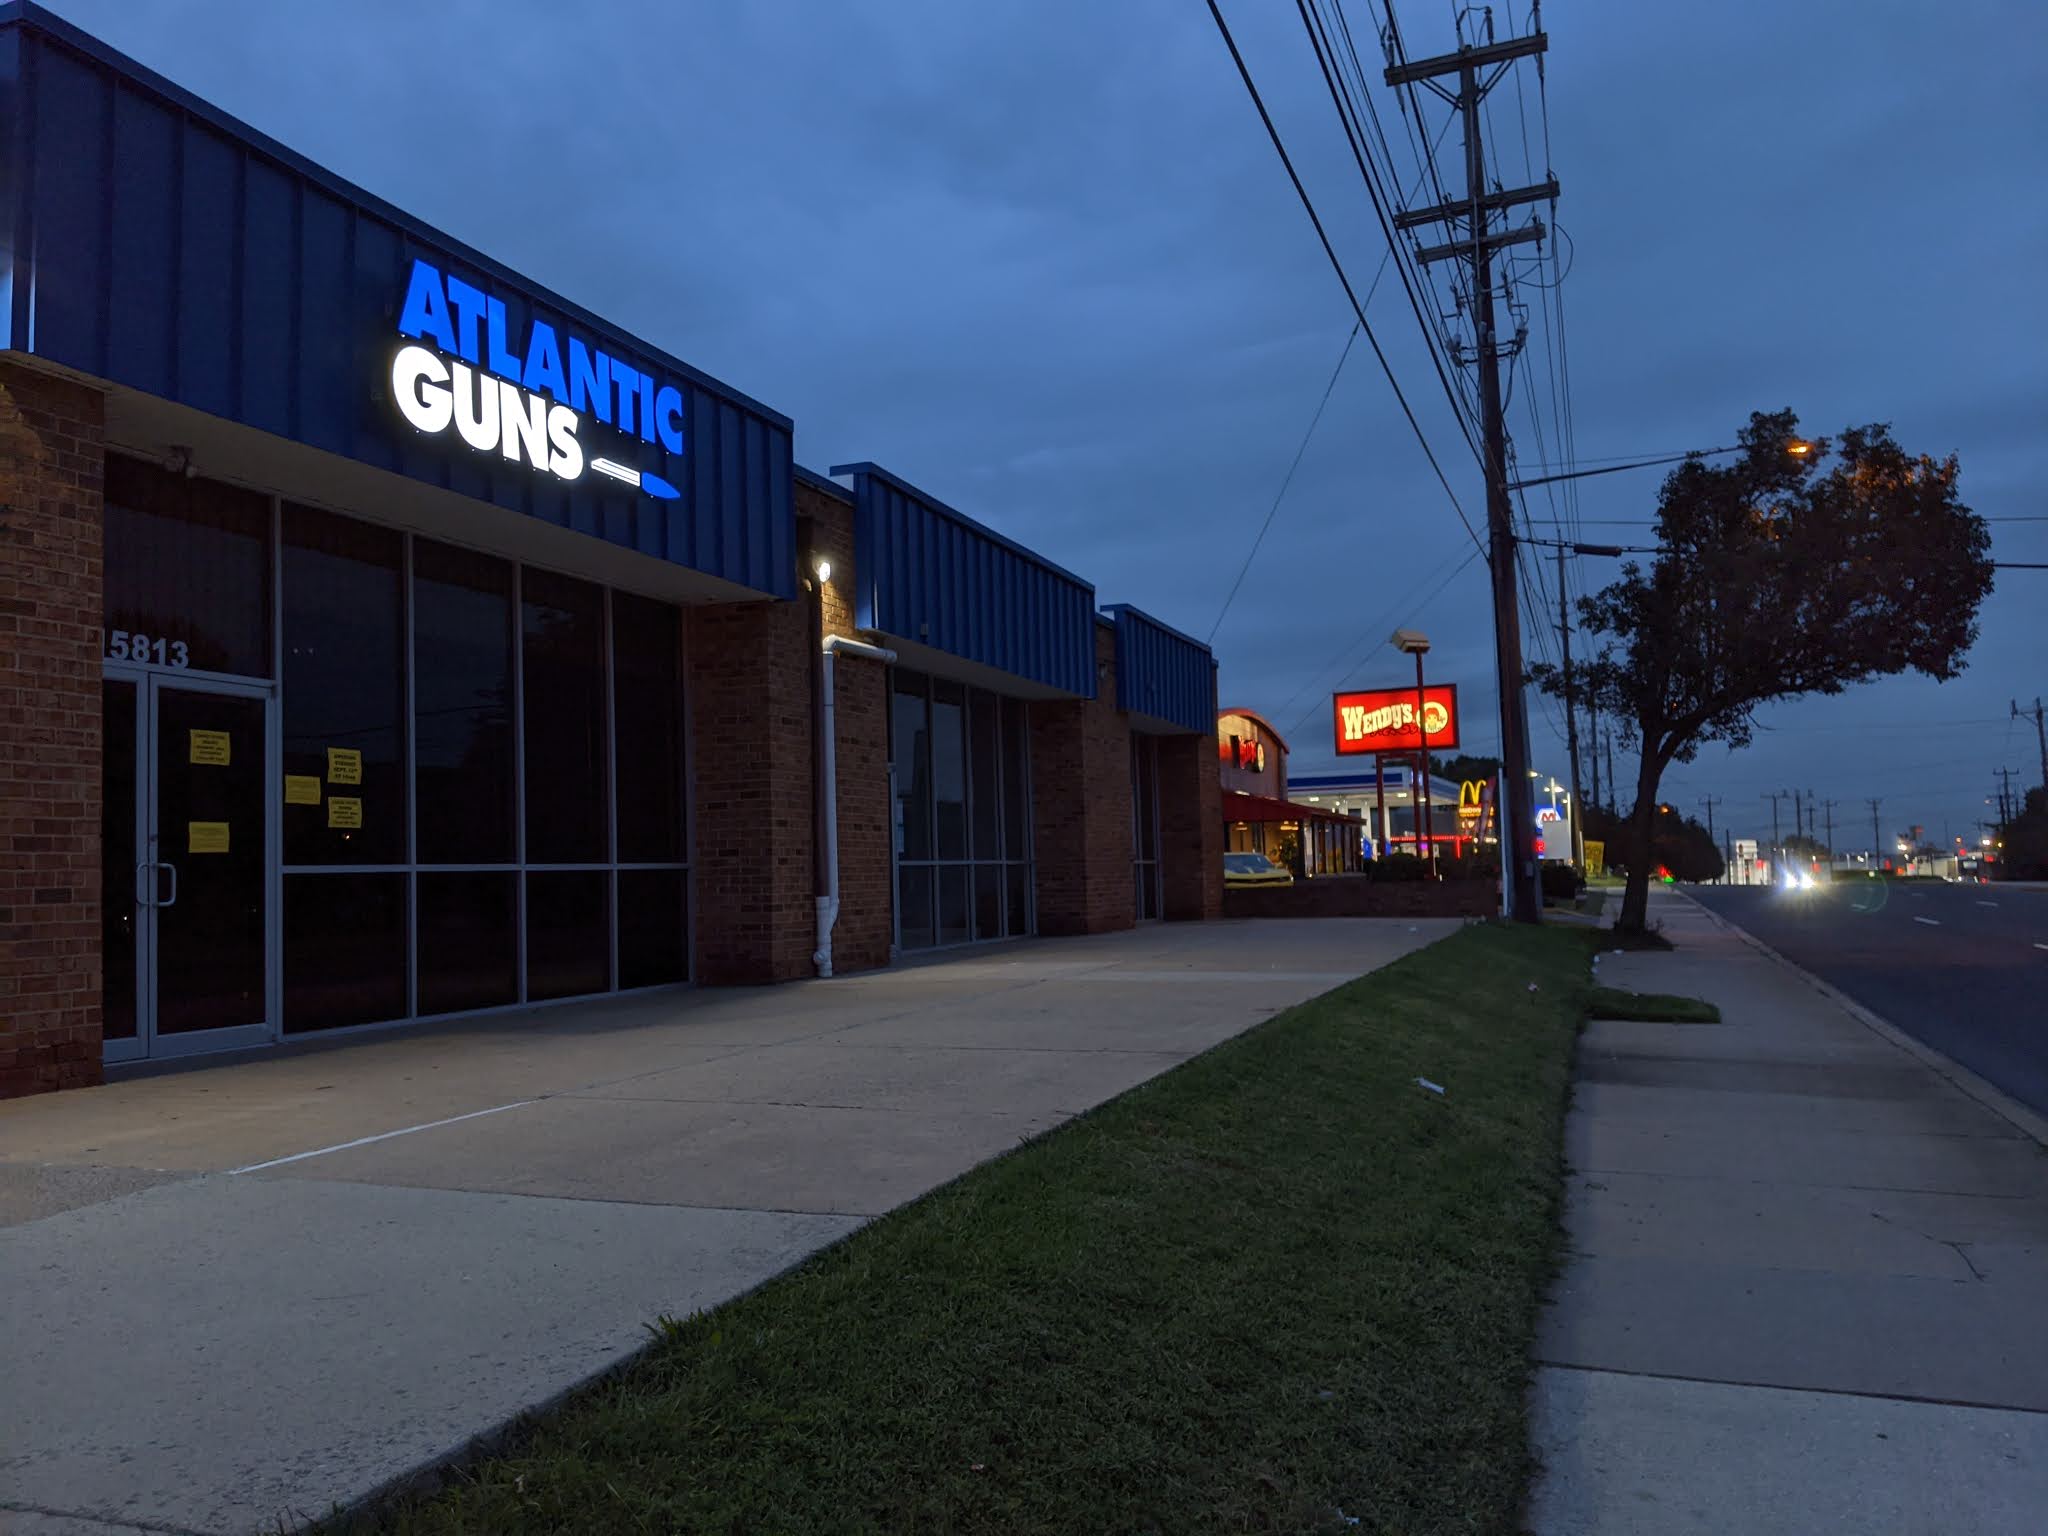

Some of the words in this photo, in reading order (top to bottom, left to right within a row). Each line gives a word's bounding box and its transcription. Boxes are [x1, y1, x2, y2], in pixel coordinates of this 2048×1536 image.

[392, 346, 583, 480] GUNS
[398, 259, 683, 455] ATLANTIC
[1341, 703, 1413, 741] Wendy's
